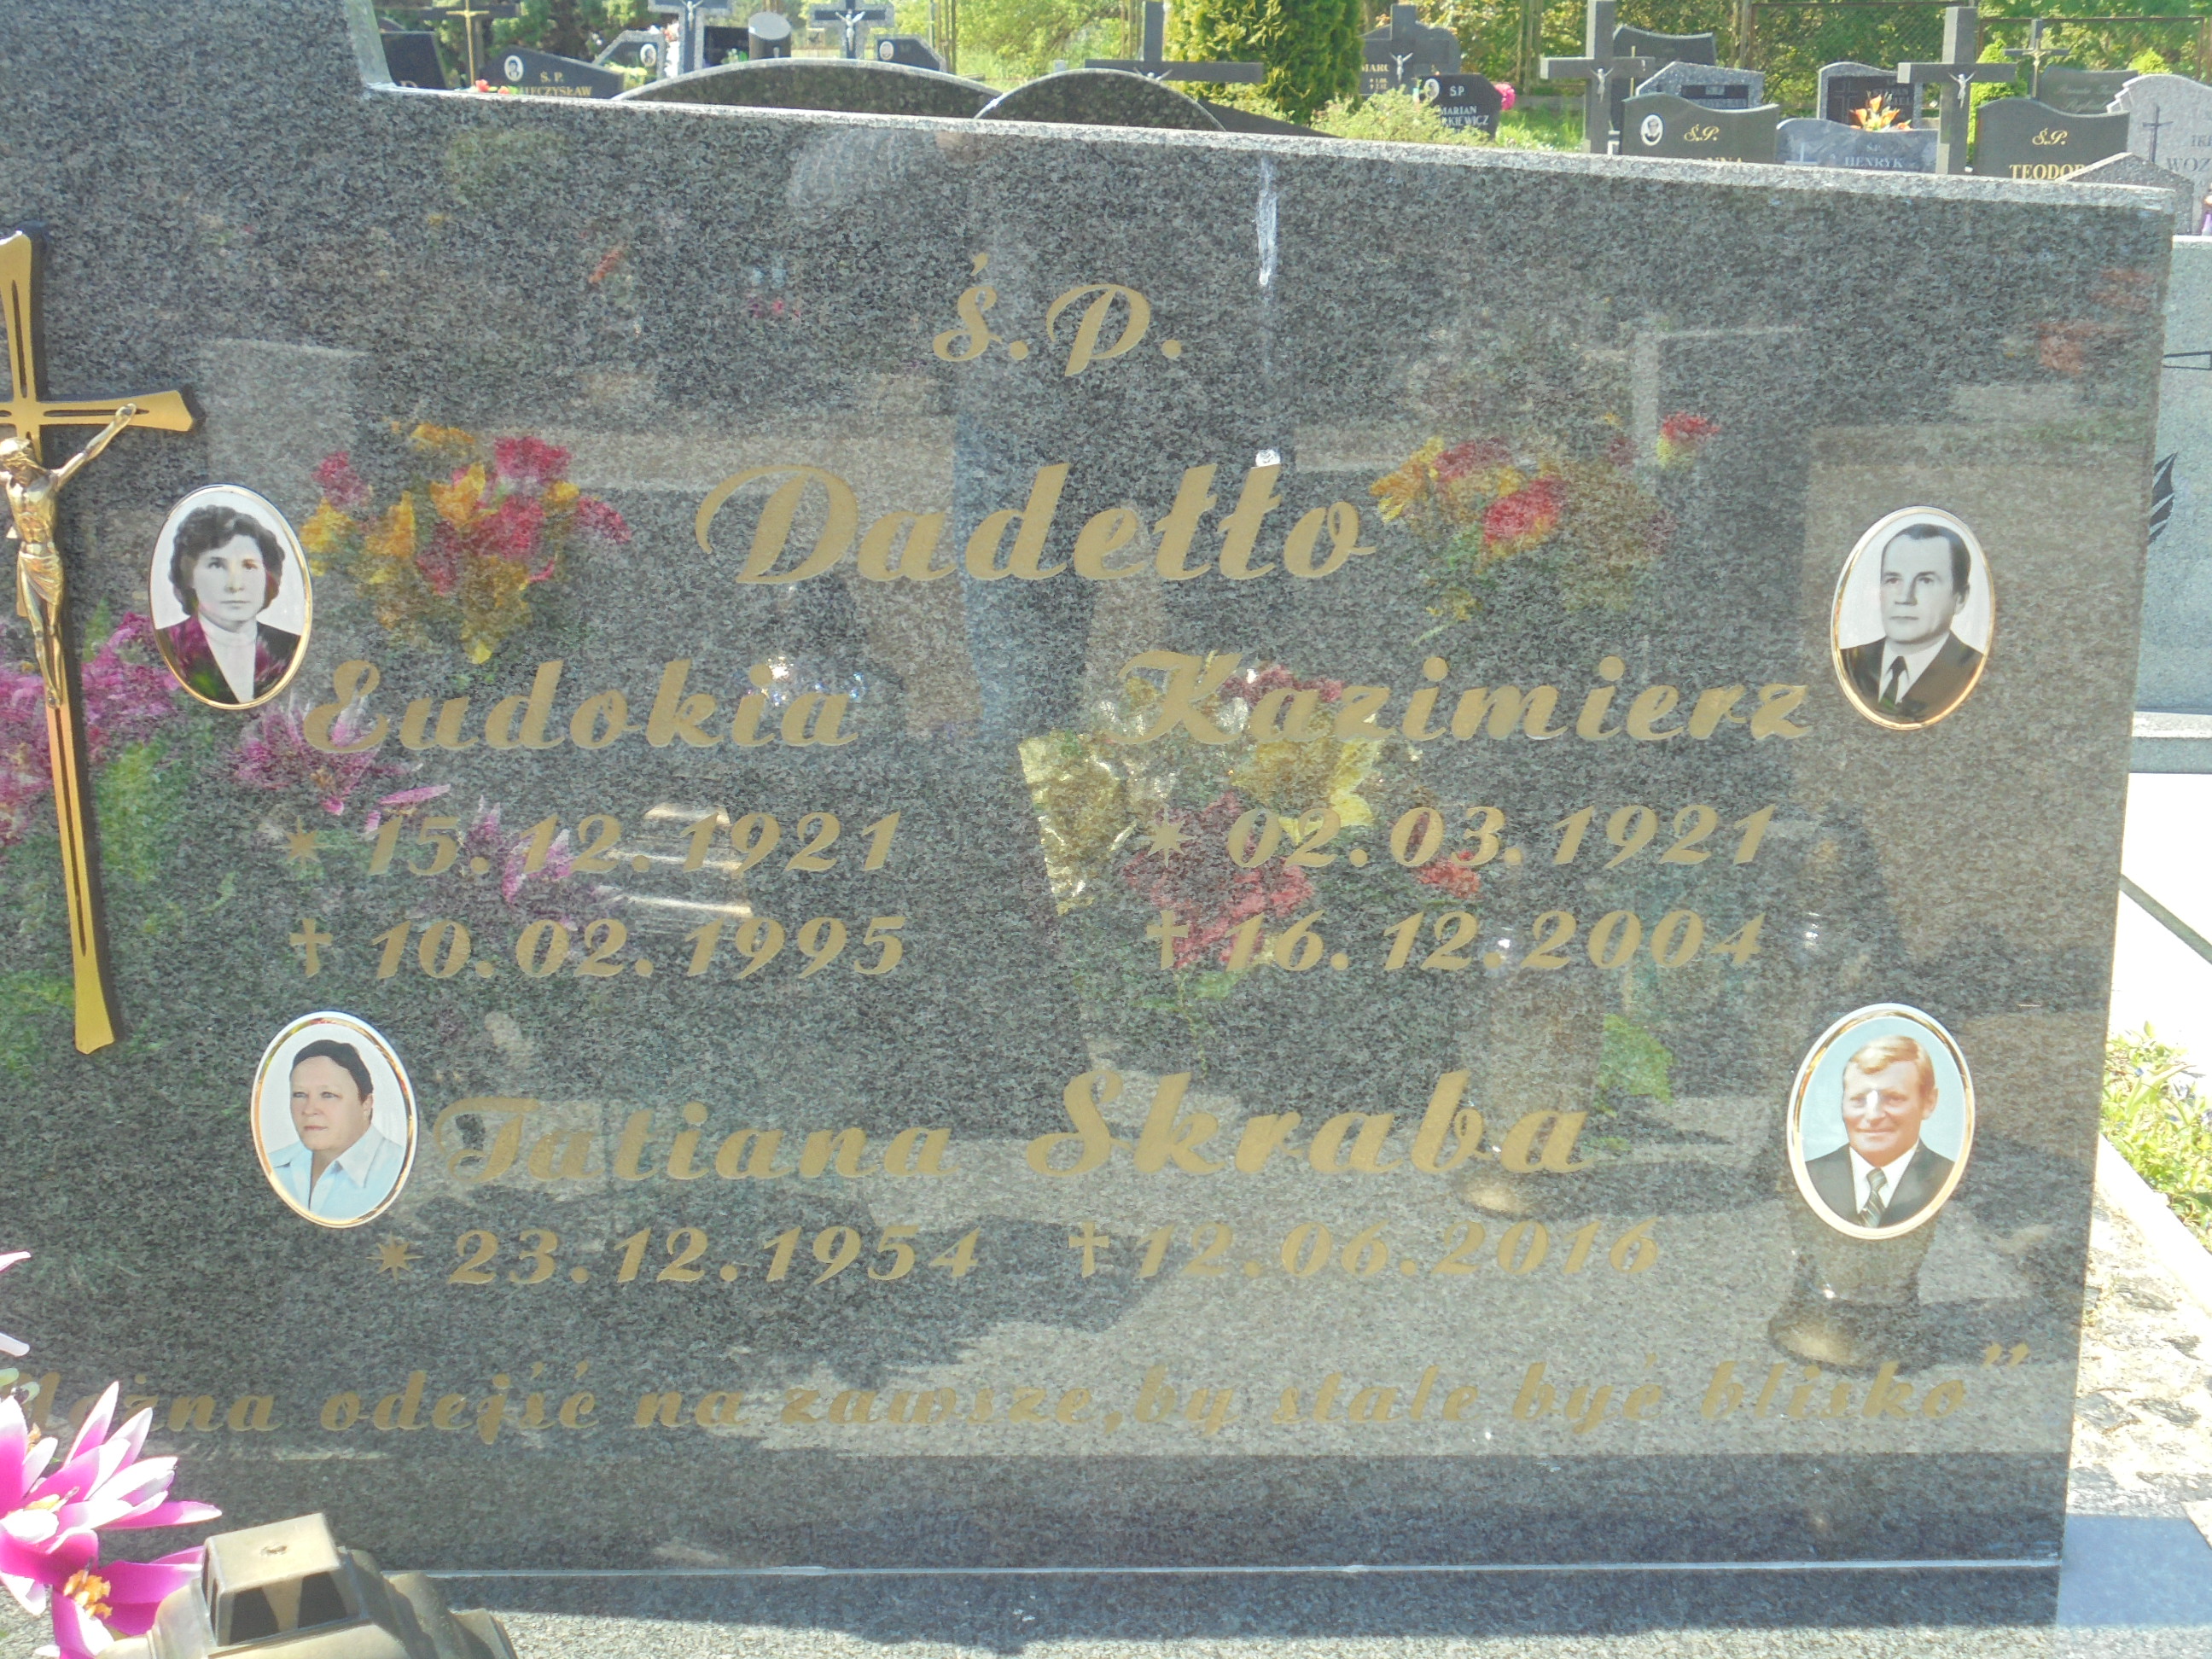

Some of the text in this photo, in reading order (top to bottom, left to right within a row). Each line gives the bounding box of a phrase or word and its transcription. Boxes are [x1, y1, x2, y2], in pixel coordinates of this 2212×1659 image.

[519, 85, 593, 96] IECZYSŁAW
[1844, 156, 1903, 169] HENRYK
[696, 463, 1376, 585] Dadetto
[304, 659, 858, 751] Eudokia
[1107, 650, 1813, 745] Kazimierz
[368, 812, 900, 876] 15.12.1921
[1227, 804, 1777, 869] 02.03.1921
[373, 917, 905, 979] 10.02.1995
[1225, 909, 1765, 971] 16.12.2004
[434, 1069, 1594, 1184] Tatiana Skraba
[448, 1220, 1658, 1284] 23.12.1954 12.06.2016
[320, 1361, 599, 1445] odejść
[633, 1387, 748, 1429] na
[1272, 1365, 1481, 1425] stale
